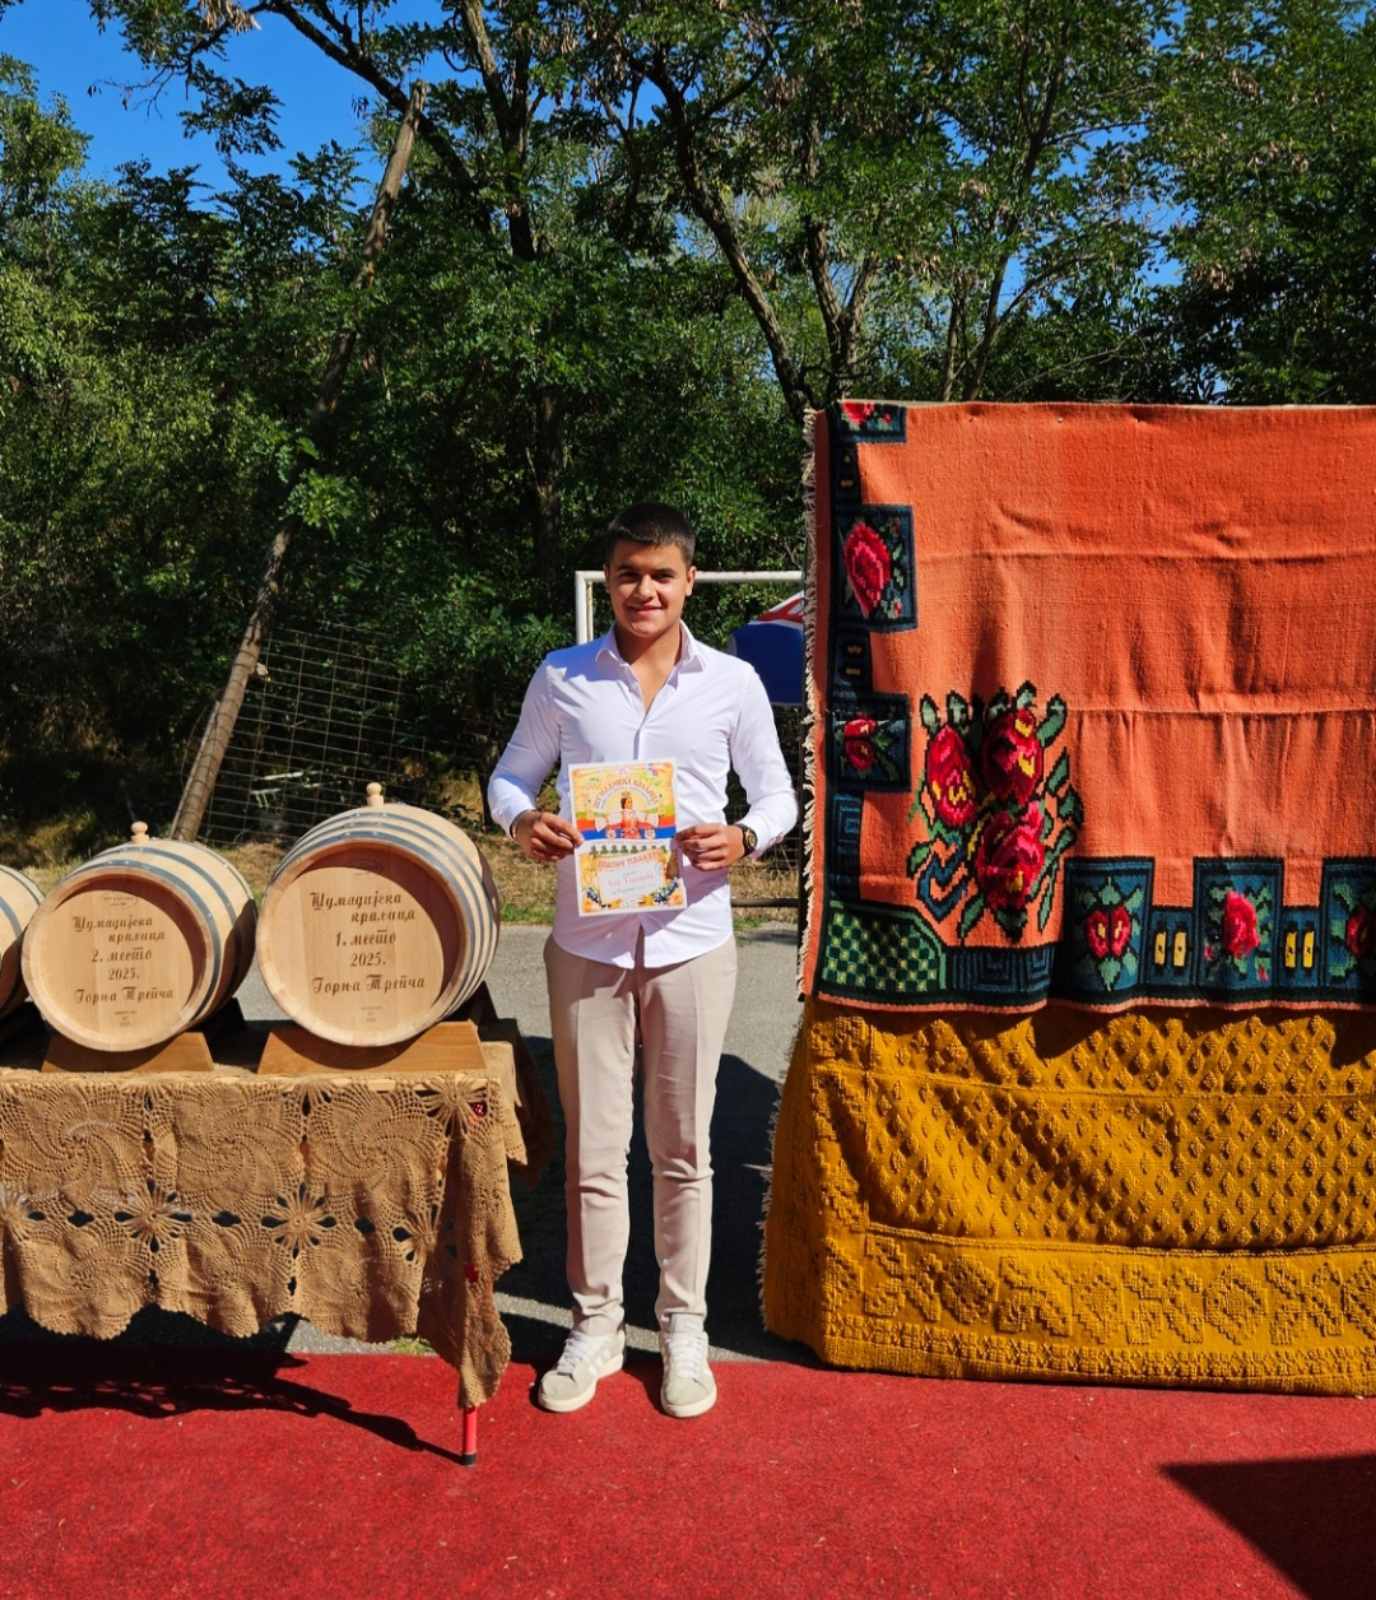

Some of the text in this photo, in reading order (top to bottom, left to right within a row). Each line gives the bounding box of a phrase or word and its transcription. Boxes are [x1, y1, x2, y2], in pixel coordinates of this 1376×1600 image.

[310, 890, 401, 910] Шумадијска
[336, 929, 396, 947] 1. место
[91, 949, 103, 962] 2.
[350, 951, 386, 967] 2025.
[108, 967, 140, 980] 2025.
